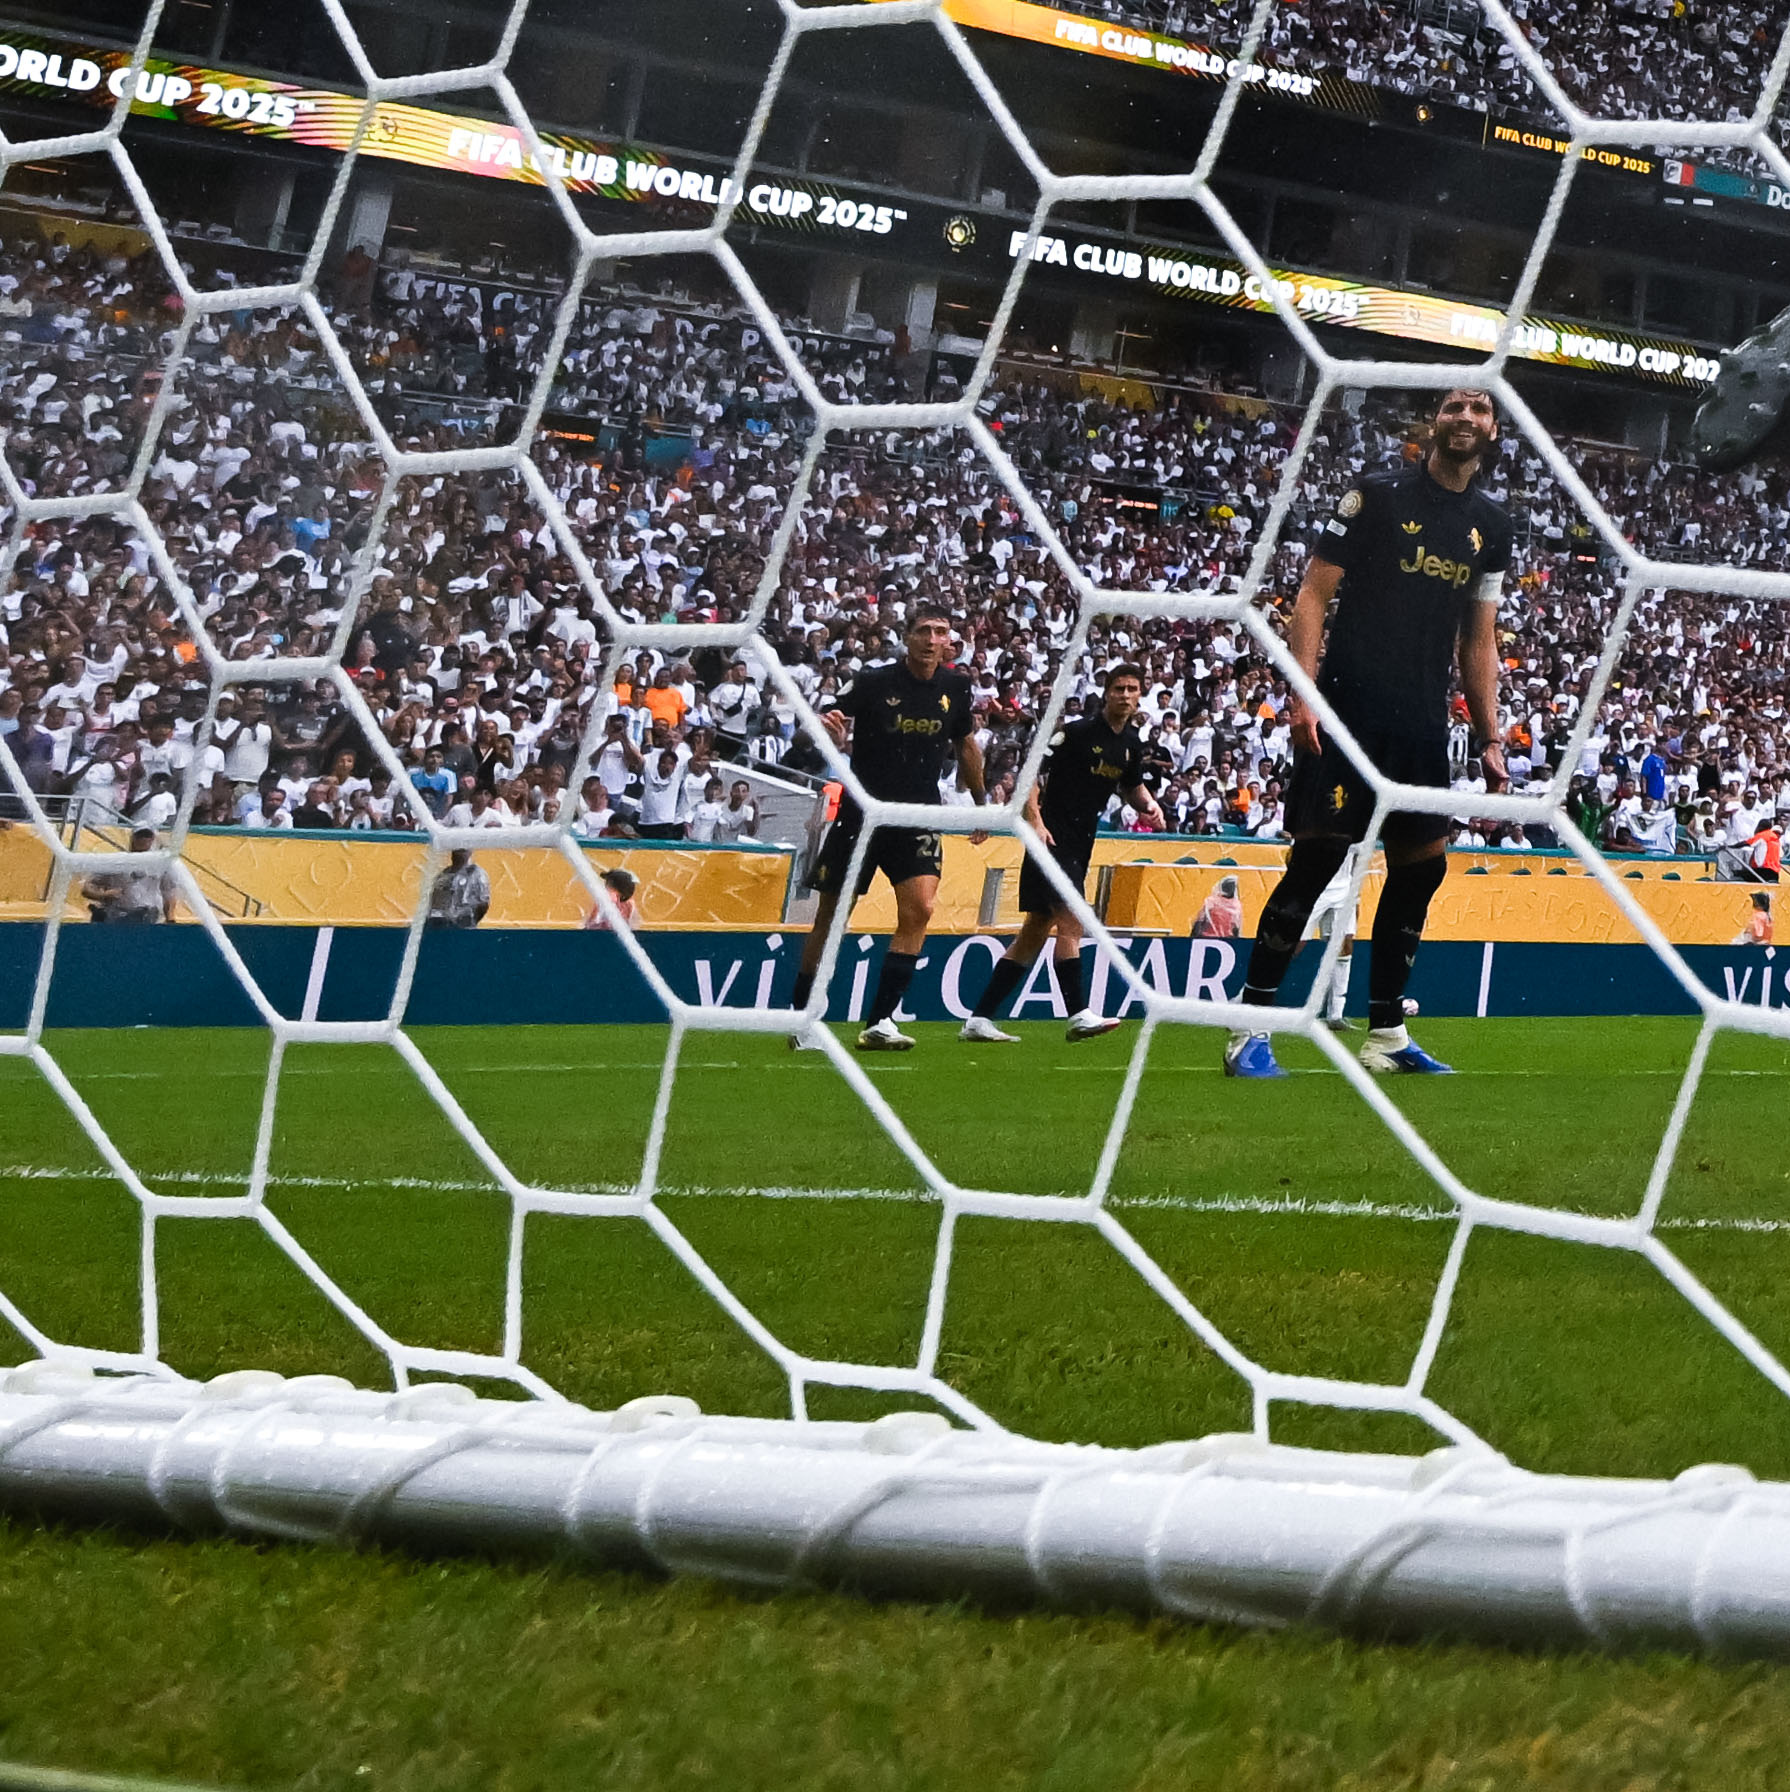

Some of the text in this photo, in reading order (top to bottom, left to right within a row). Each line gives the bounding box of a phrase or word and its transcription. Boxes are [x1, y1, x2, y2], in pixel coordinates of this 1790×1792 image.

[0, 43, 101, 92] ORLD
[106, 66, 193, 107] CUP
[1055, 18, 1315, 97] FIFA CLUB WORLD CUP 2025
[447, 126, 523, 170] FIFA
[623, 158, 744, 207] WORLD
[747, 182, 814, 219] CUP
[1494, 124, 1521, 145] FIFA
[1522, 131, 1553, 152] CLUB
[1555, 139, 1597, 162] WOLD
[1597, 150, 1622, 167] CUP
[1071, 243, 1144, 281] CLUB
[1146, 256, 1241, 296] WORLD
[1243, 272, 1293, 305] CUP
[1297, 285, 1360, 319] 2025
[1449, 312, 1498, 344] FIFA
[1561, 332, 1637, 368] WORLD
[1637, 347, 1681, 375] CUP
[1681, 356, 1722, 384] 202
[1399, 545, 1472, 590] Jeep
[887, 713, 944, 737] Jeep
